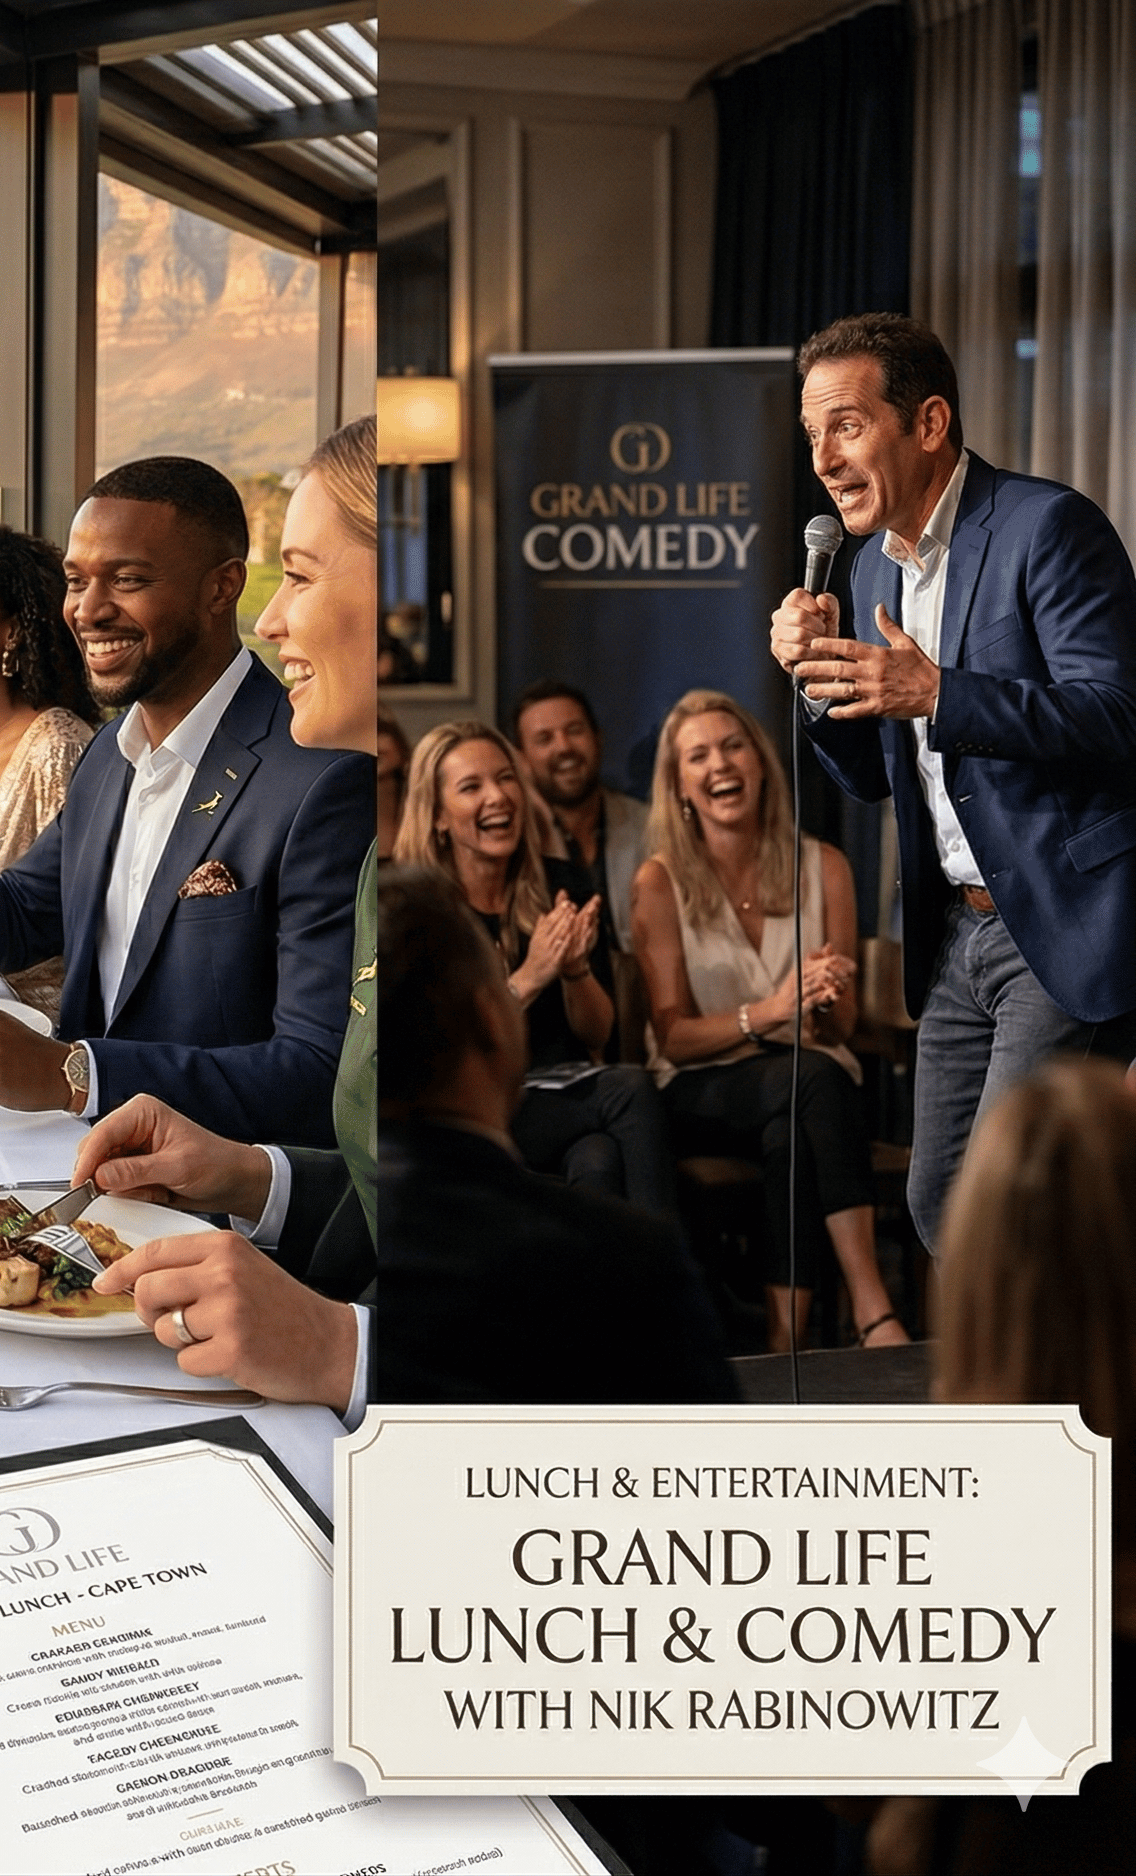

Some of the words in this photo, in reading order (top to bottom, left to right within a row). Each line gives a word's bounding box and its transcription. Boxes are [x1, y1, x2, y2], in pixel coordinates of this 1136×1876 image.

[529, 482, 668, 518] GRAND
[675, 482, 751, 517] LIFE
[522, 523, 760, 571] COMEDY
[65, 1545, 129, 1571] LIFE
[88, 1577, 142, 1597] CAPE
[142, 1563, 207, 1585] TOWN
[52, 1616, 105, 1637] MENU
